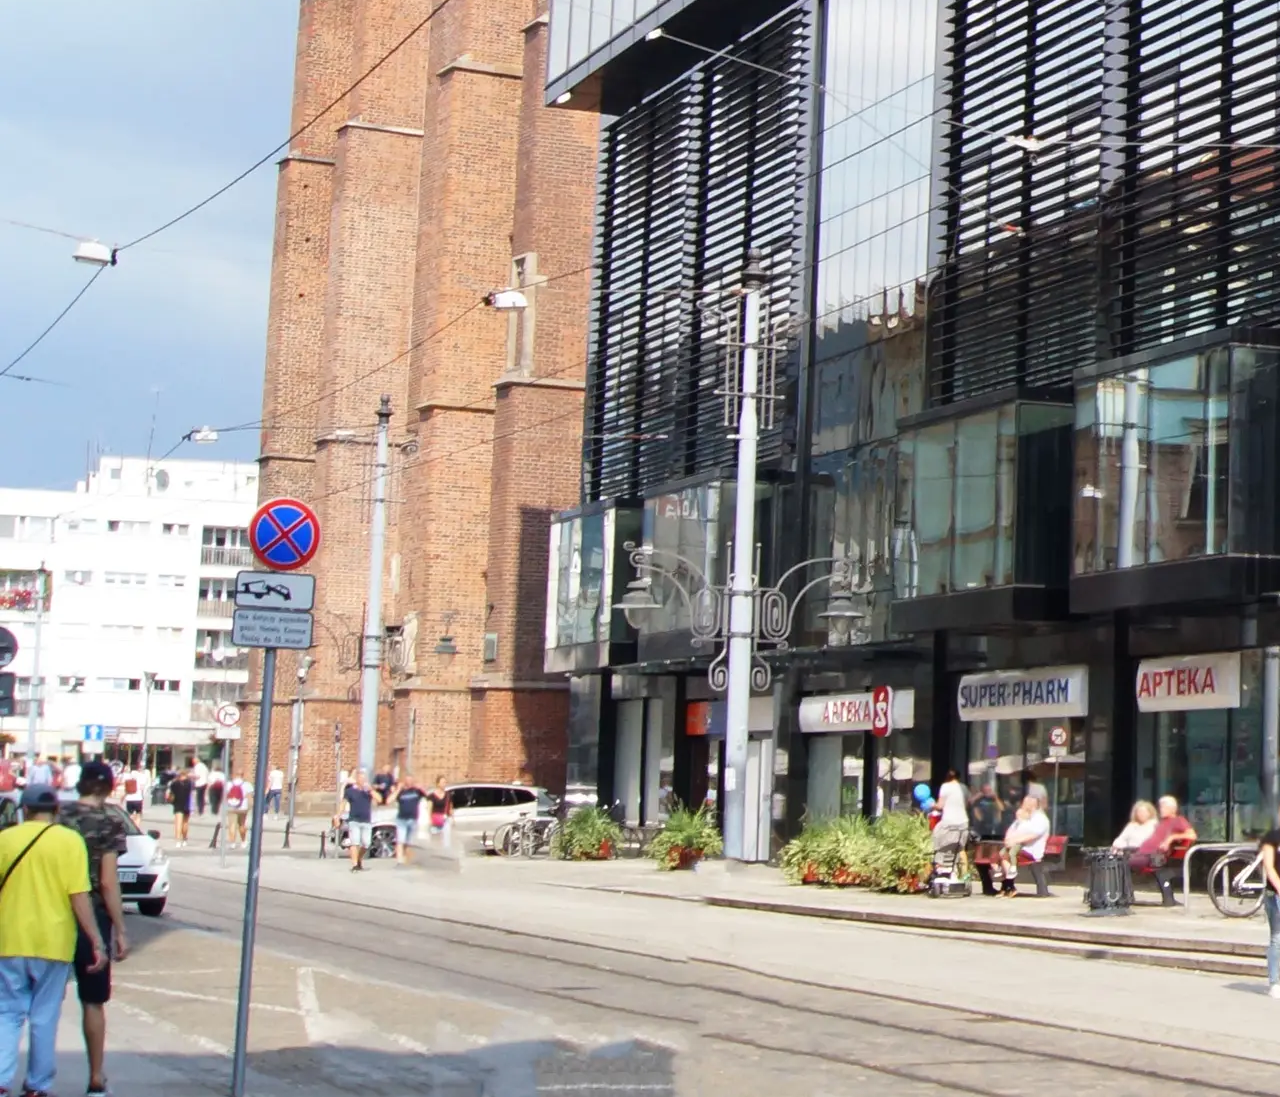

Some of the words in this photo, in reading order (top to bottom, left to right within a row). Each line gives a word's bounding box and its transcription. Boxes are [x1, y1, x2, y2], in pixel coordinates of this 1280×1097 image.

[960, 677, 1069, 709] SUPER-PHARM
[1139, 667, 1215, 698] APTEKA
[823, 700, 870, 723] APTEKA
